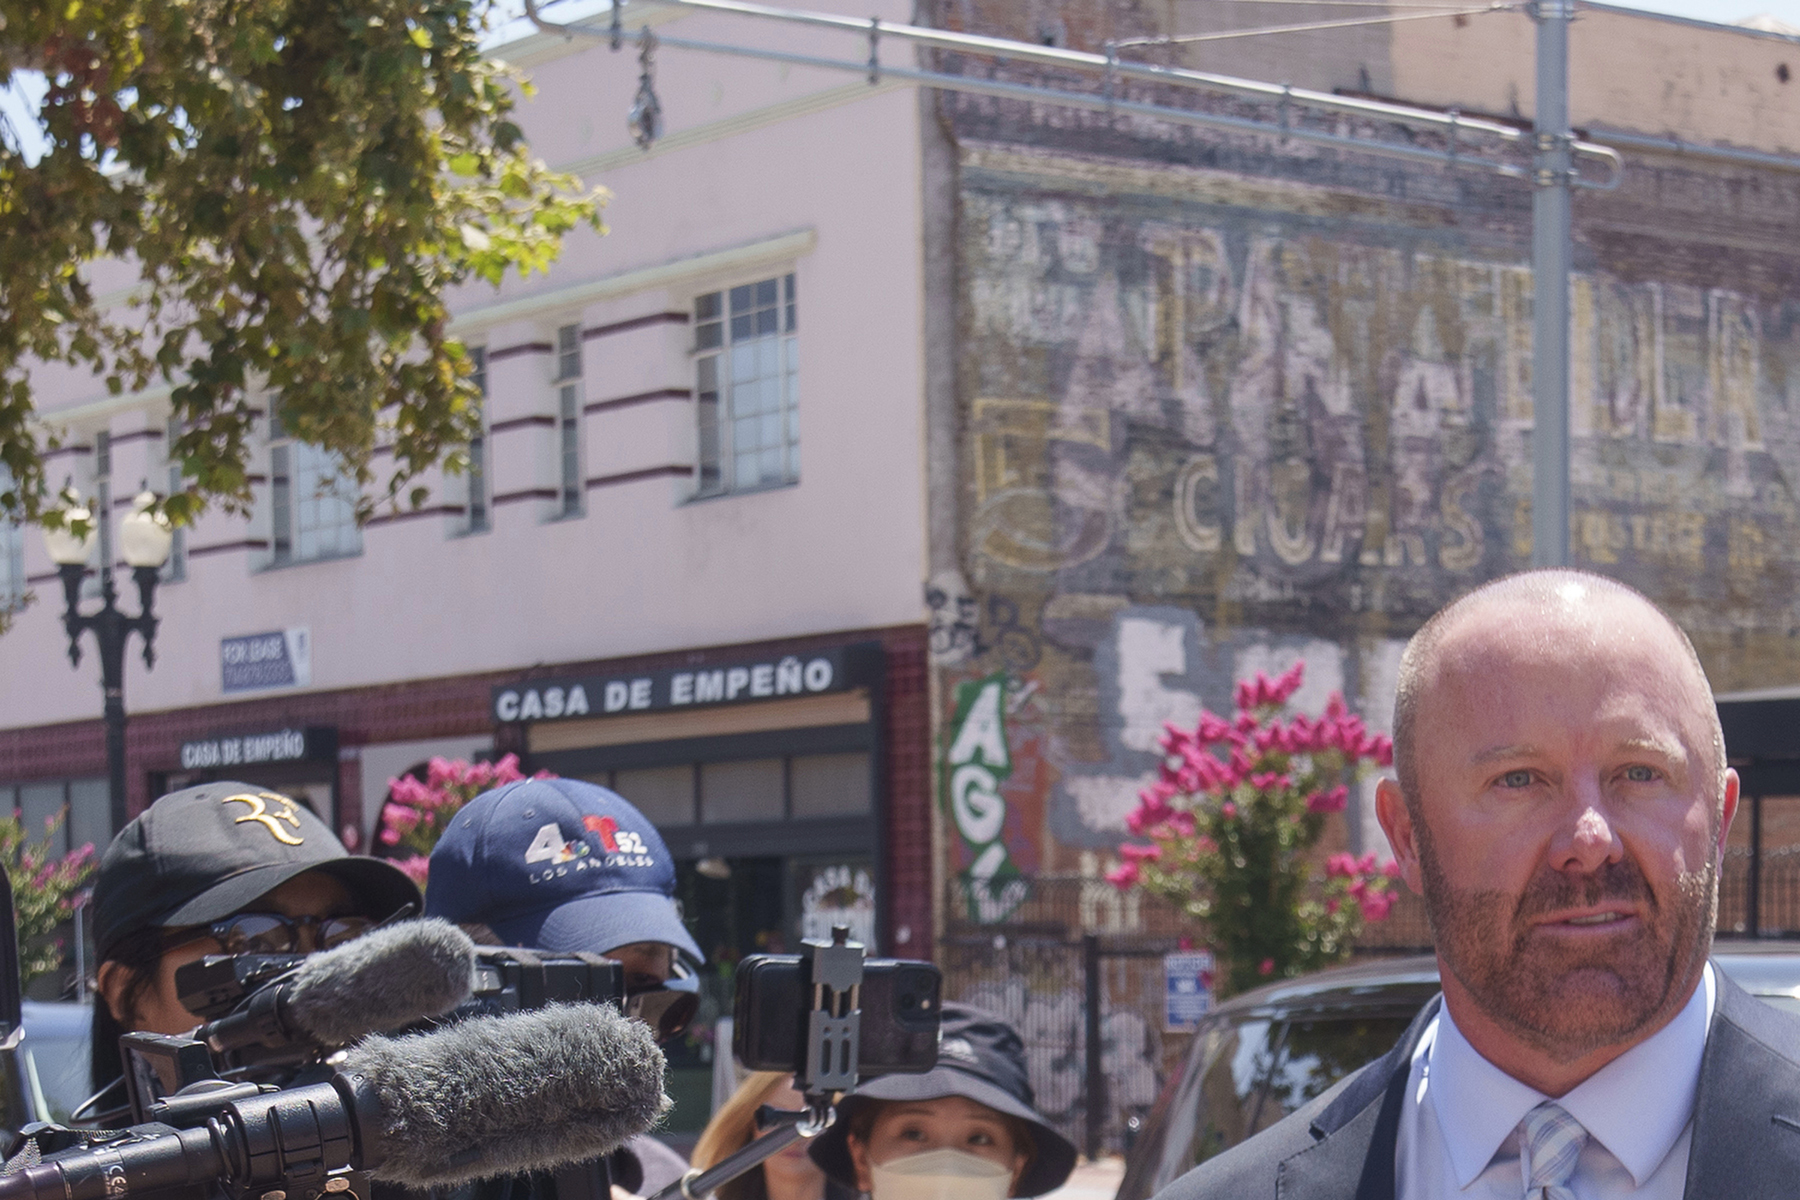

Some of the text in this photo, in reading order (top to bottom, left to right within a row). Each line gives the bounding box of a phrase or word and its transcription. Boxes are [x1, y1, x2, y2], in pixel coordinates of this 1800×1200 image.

[496, 655, 833, 722] CASA DE EMPEÑO
[181, 728, 305, 769] CASA DE EMPEÑO
[614, 831, 648, 855] 52
[529, 854, 654, 884] LOS ANGELES
